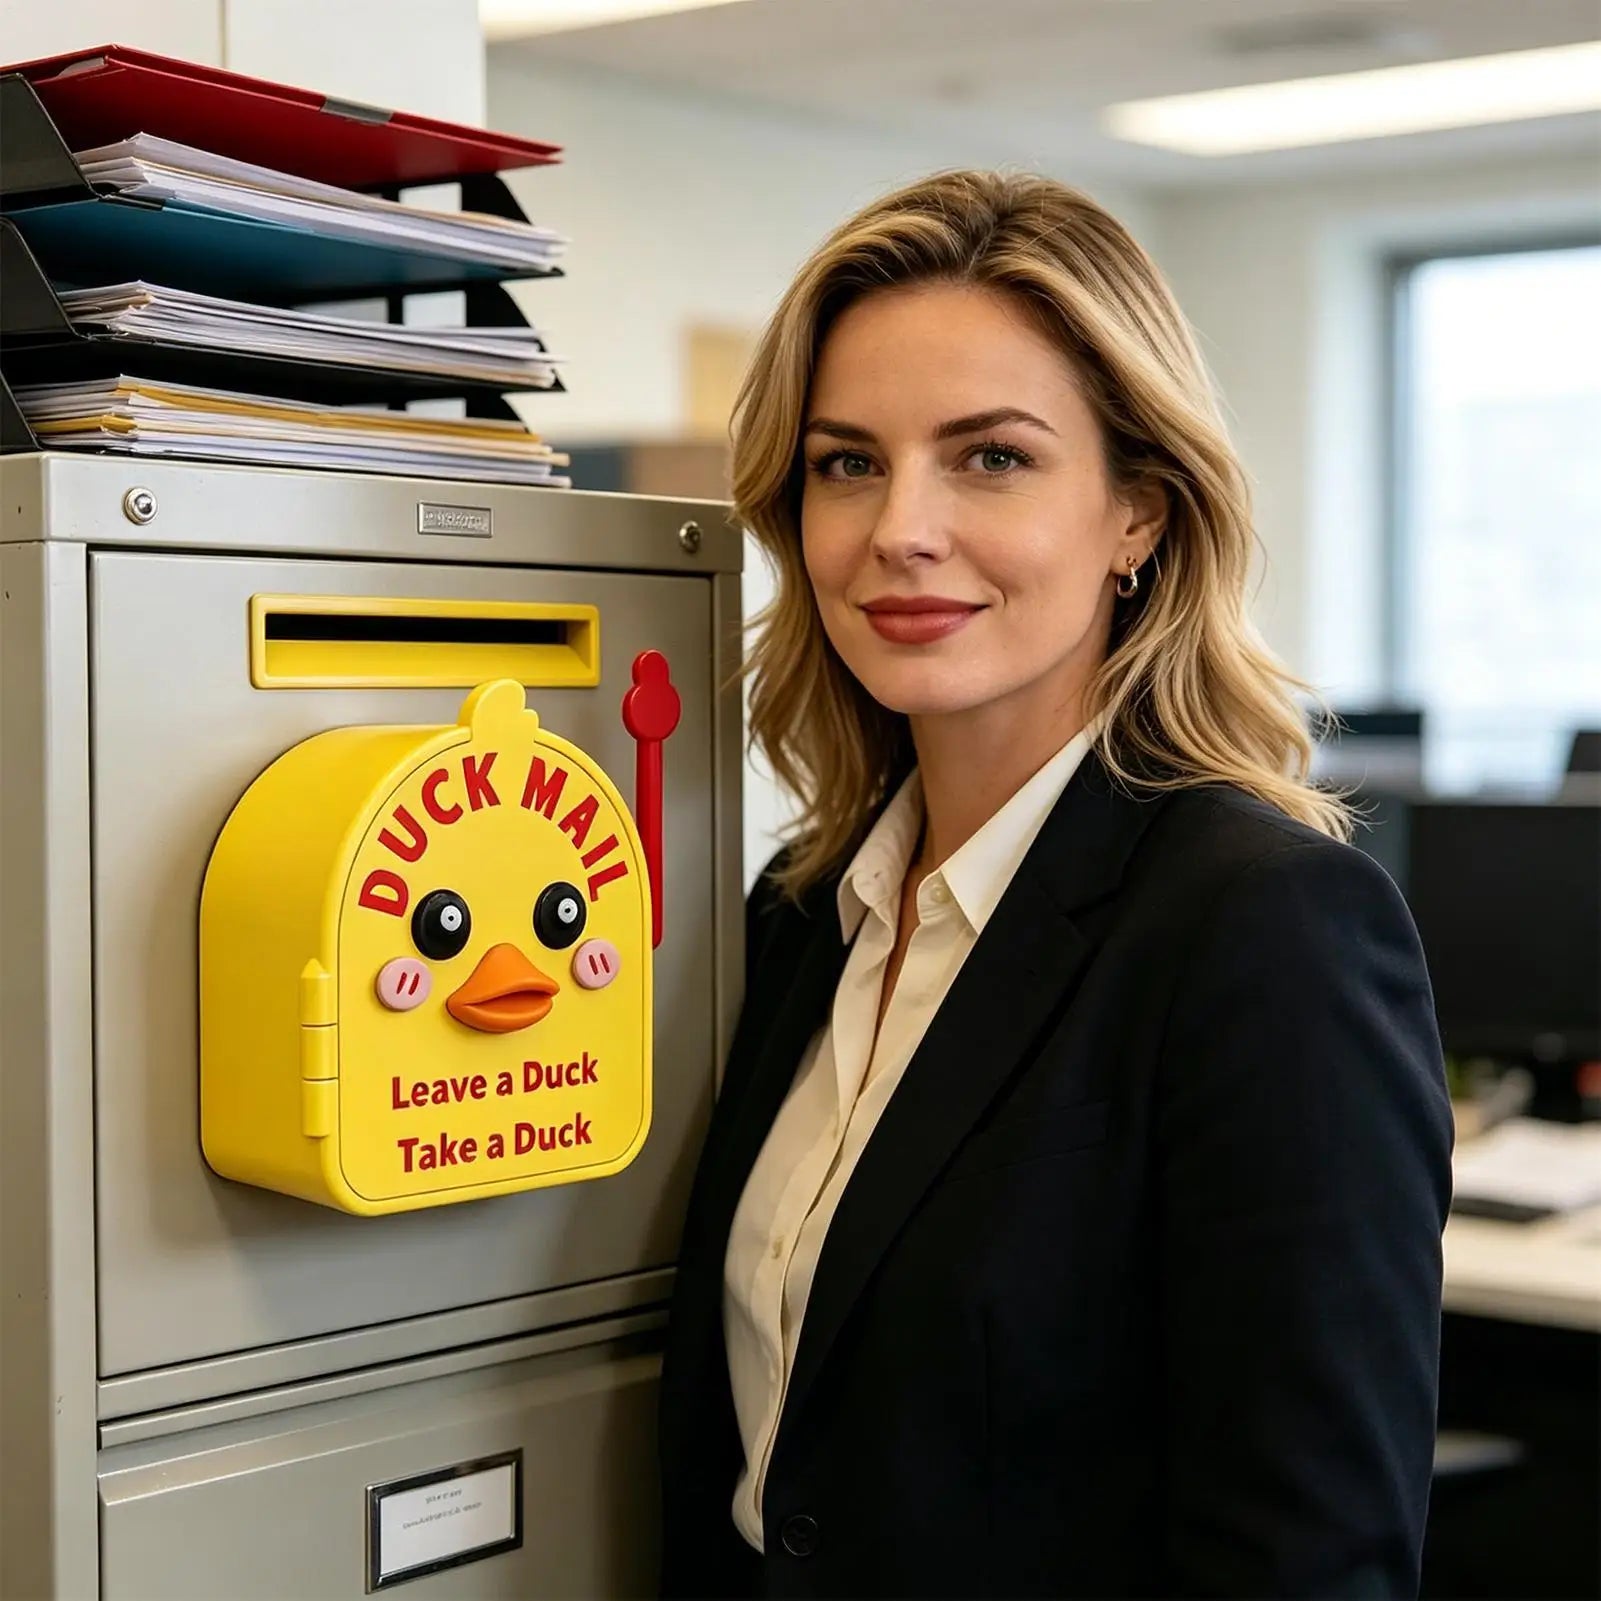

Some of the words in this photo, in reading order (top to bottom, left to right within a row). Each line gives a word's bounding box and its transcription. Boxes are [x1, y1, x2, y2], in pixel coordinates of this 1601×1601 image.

[358, 752, 501, 918] DUCK
[521, 756, 629, 903] MAIL
[392, 1075, 487, 1110] Leave
[496, 1072, 513, 1096] a
[523, 1051, 598, 1093] Duck
[397, 1132, 477, 1172] Take
[486, 1134, 505, 1159] a
[514, 1112, 592, 1155] Duck
